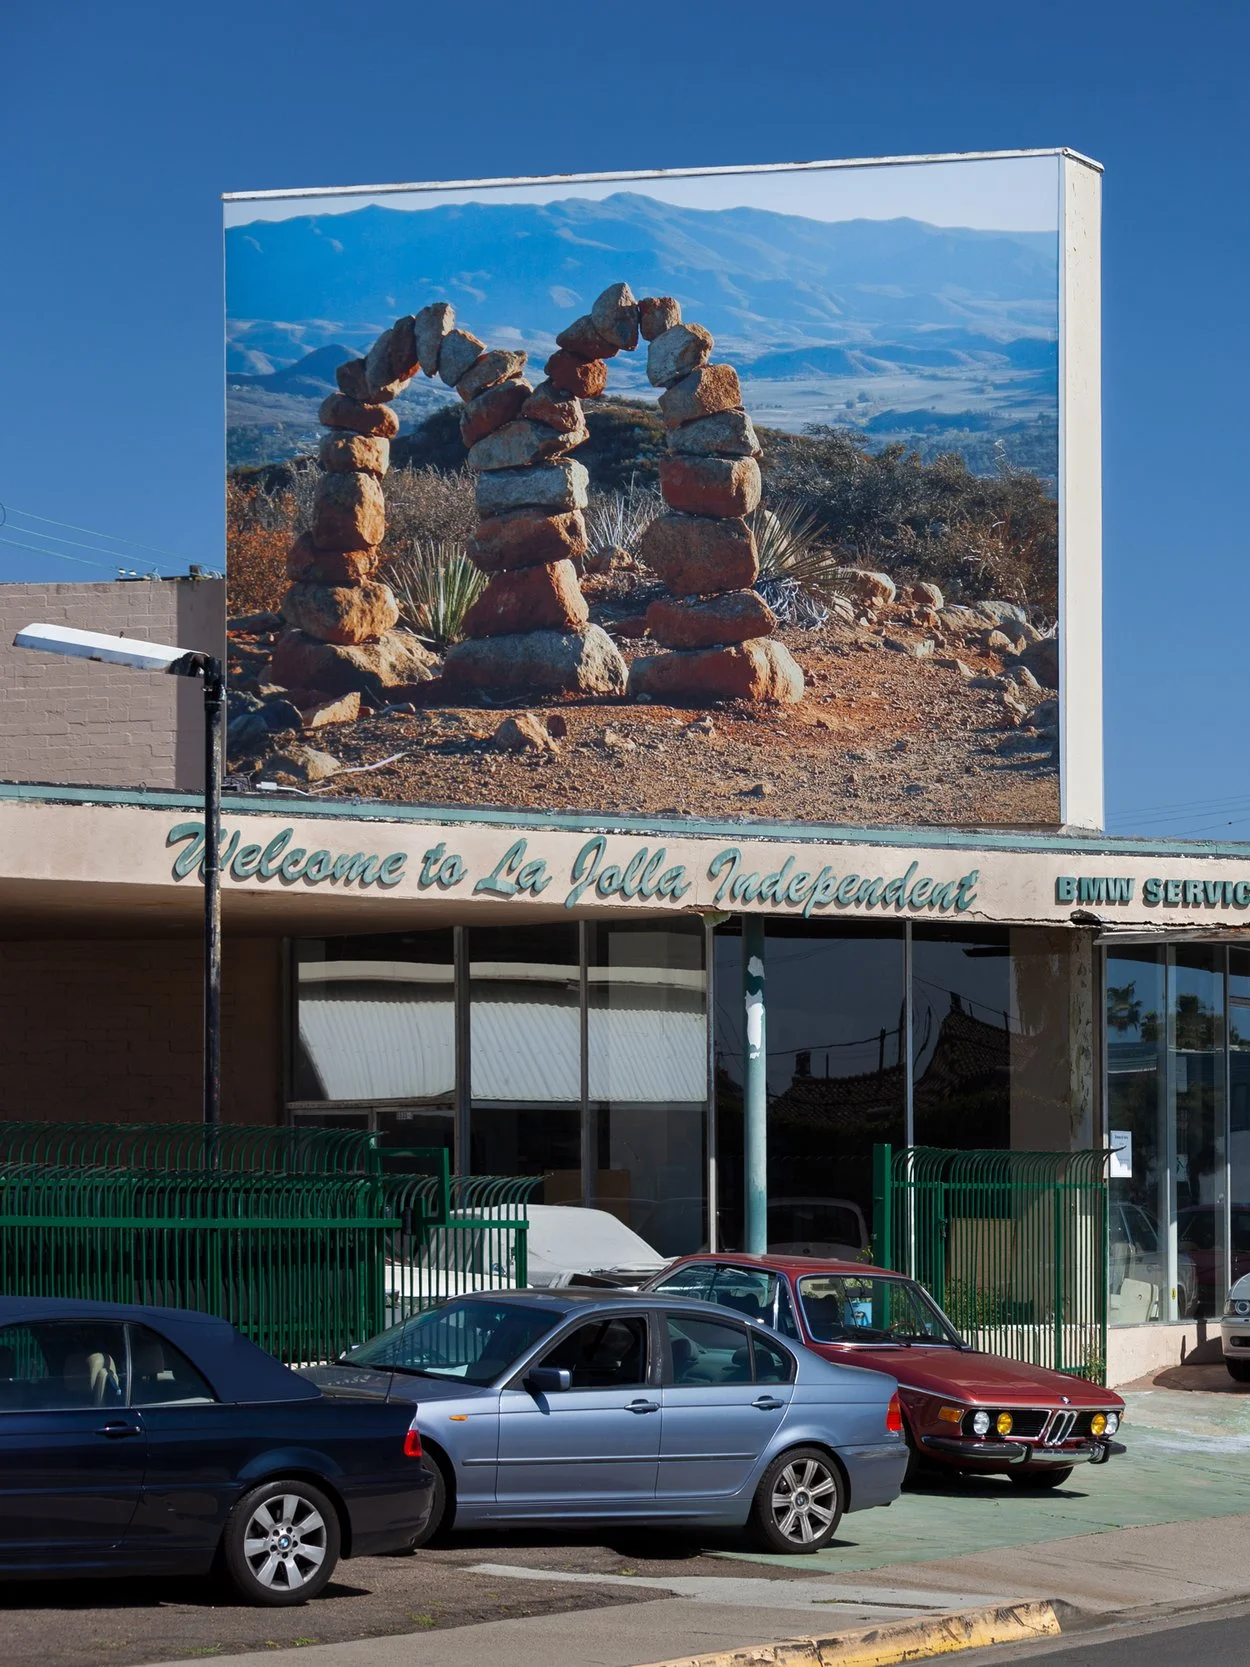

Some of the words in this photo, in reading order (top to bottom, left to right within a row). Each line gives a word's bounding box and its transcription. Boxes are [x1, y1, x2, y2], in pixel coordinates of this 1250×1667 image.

[167, 821, 408, 885] Welcome
[419, 842, 468, 886] to
[475, 838, 552, 895] La
[564, 835, 692, 909] Jolla
[708, 847, 980, 919] Independent
[1057, 876, 1135, 901] BMW
